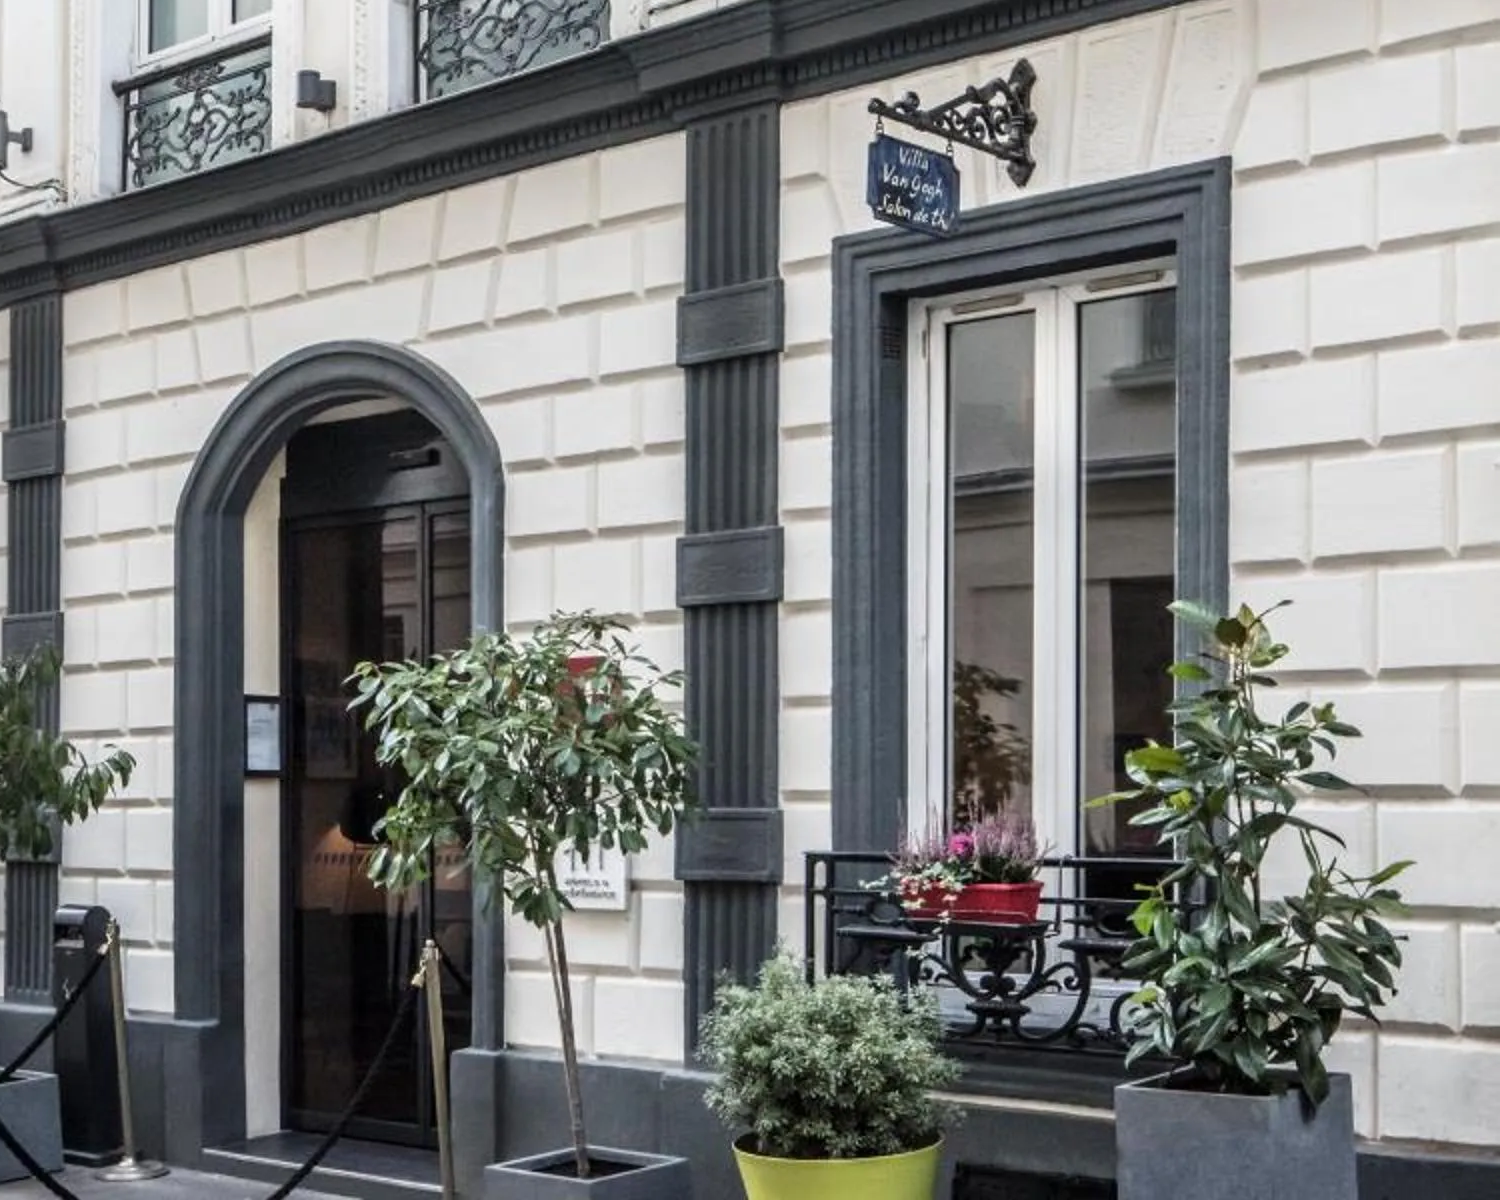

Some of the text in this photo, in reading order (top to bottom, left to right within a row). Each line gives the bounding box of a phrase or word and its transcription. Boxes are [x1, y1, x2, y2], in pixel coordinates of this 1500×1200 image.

[899, 145, 929, 171] Villa
[883, 162, 943, 204] Van Gogh
[877, 193, 911, 220] Salon
[913, 208, 929, 223] de
